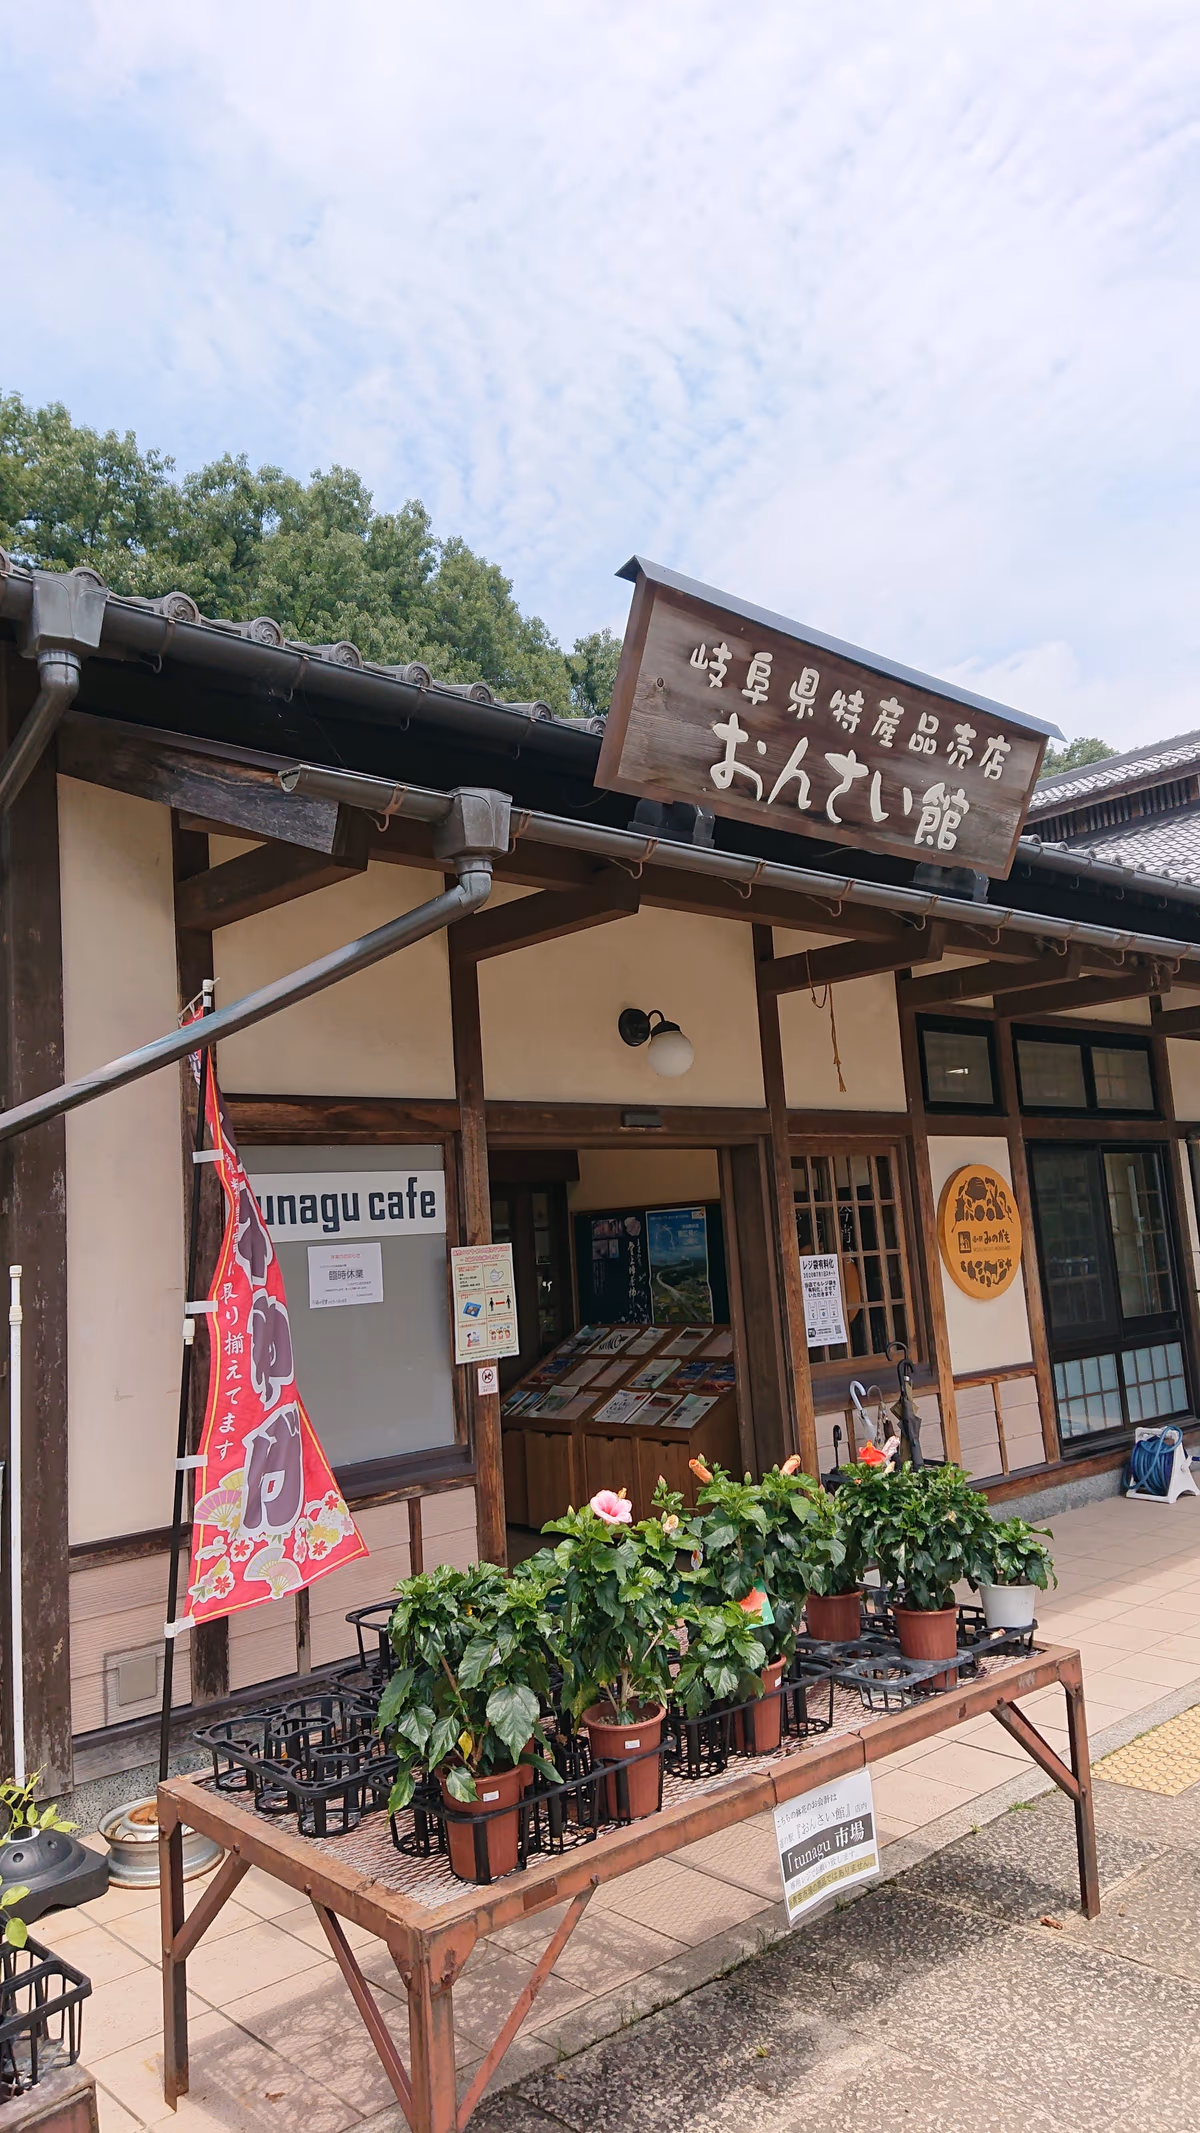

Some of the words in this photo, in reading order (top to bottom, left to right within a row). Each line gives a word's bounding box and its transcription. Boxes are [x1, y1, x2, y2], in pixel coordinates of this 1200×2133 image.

[689, 641, 1012, 781] 岐阜県特産品売店
[709, 712, 970, 852] おんさい館
[258, 1191, 360, 1233] unagu
[369, 1177, 436, 1221] cafe
[328, 1269, 364, 1281] 臨時休業
[803, 1259, 834, 1270] レジ袋有料化
[834, 1820, 865, 1848] 市場
